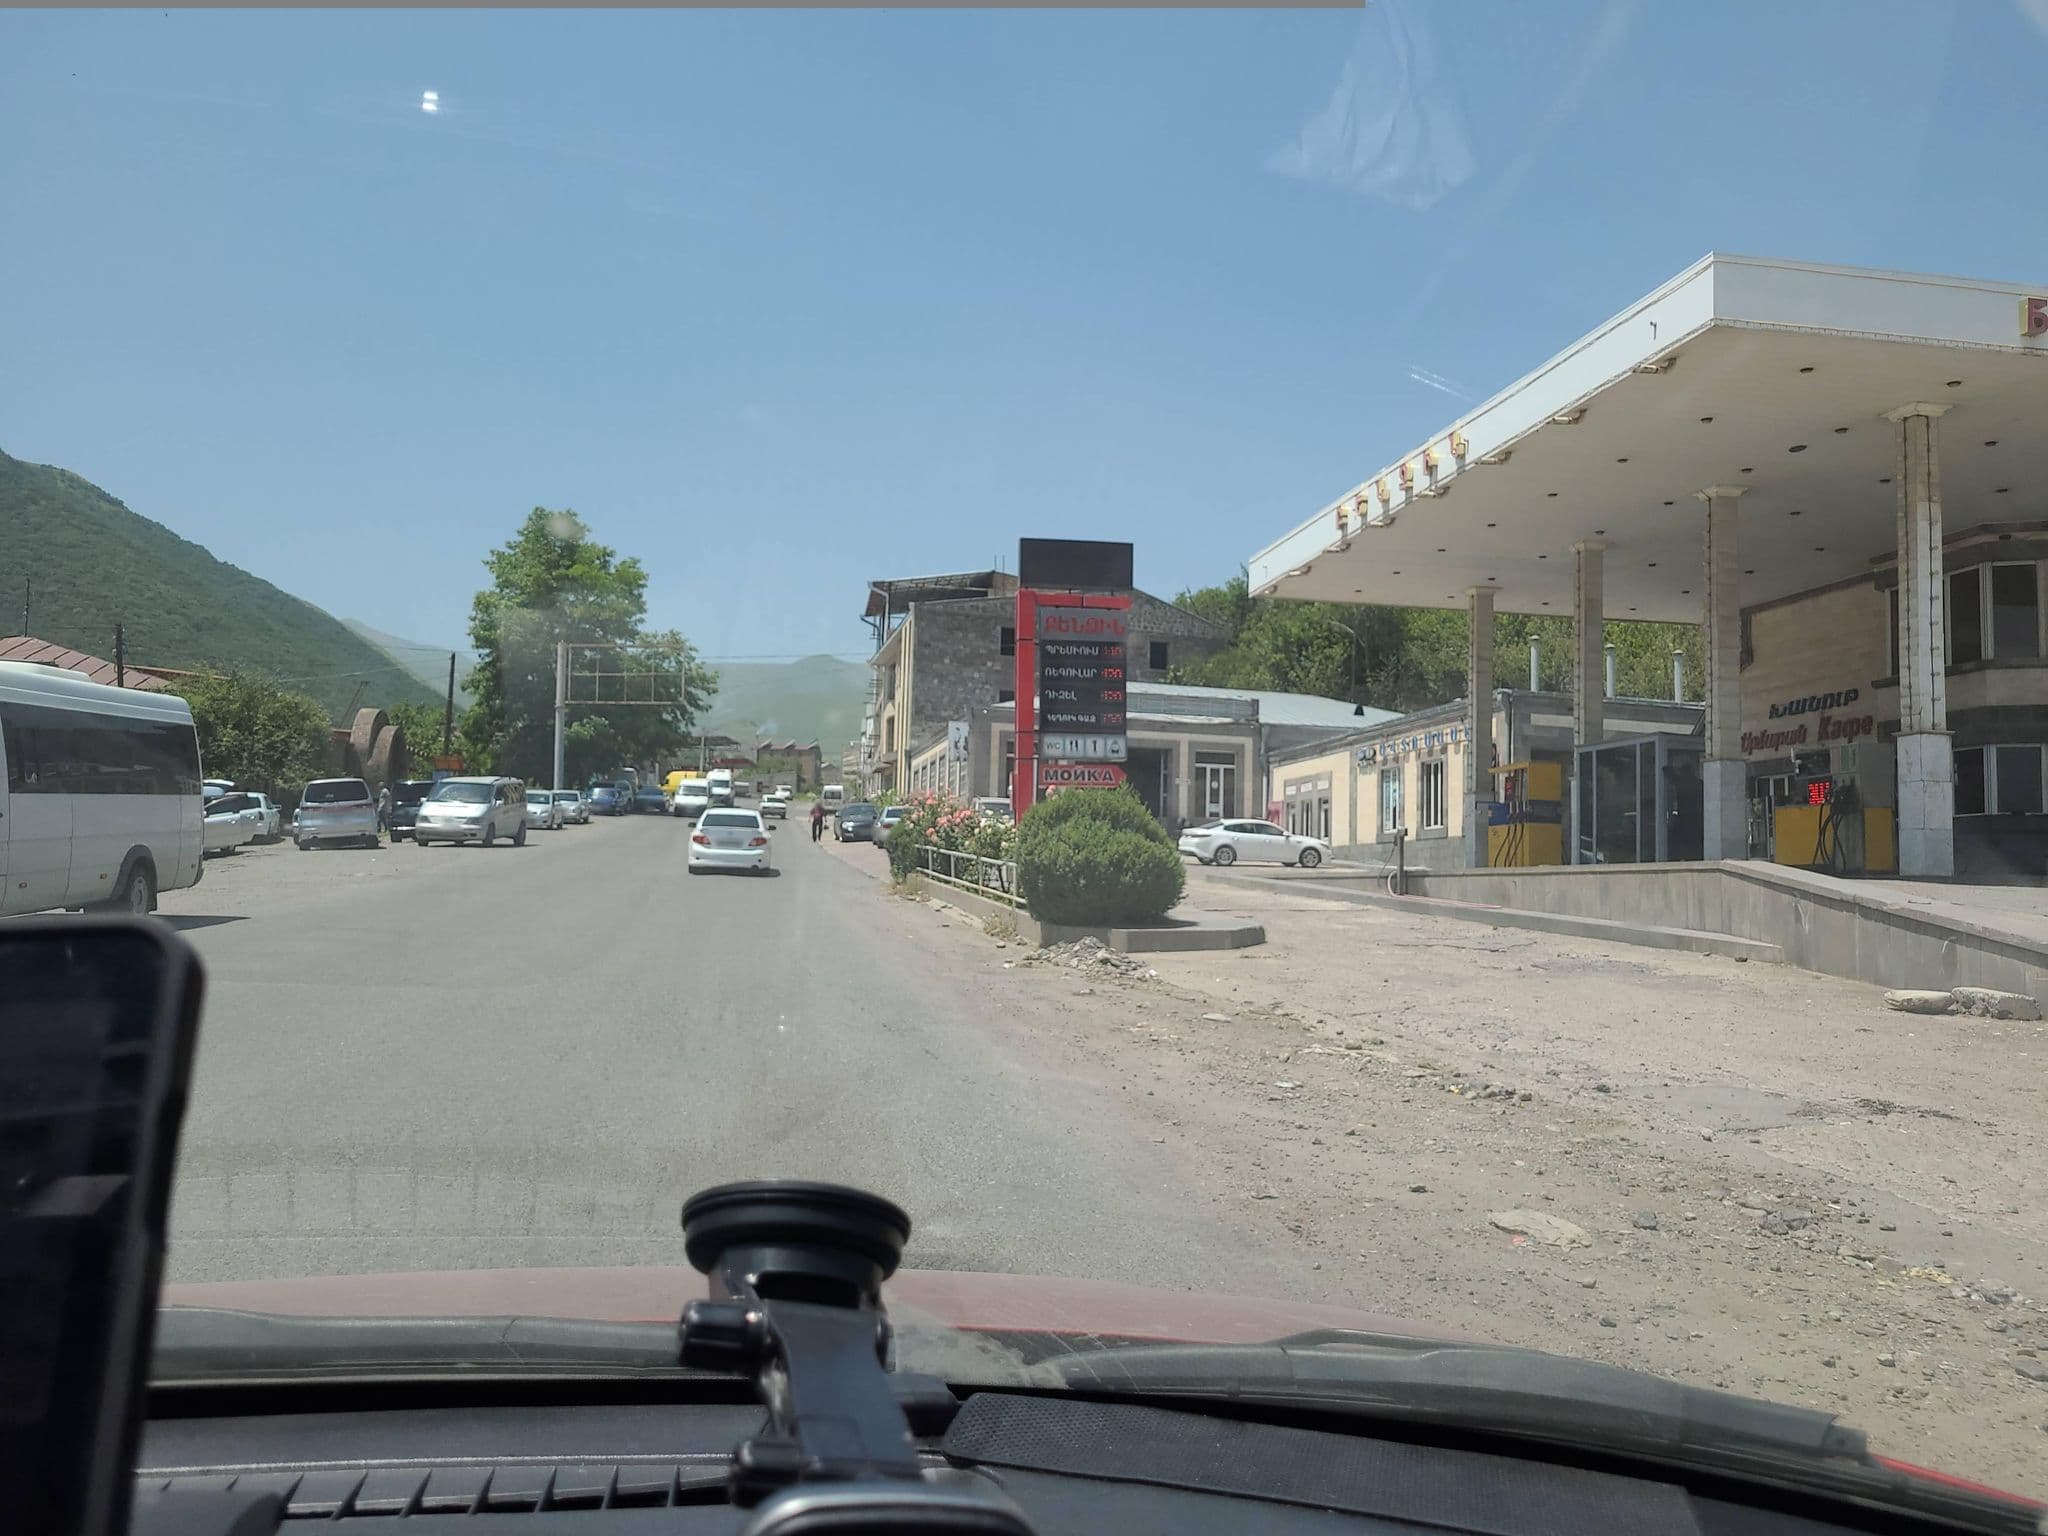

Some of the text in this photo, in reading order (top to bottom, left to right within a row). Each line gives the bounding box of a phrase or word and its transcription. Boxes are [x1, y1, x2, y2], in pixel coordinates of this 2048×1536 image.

[1045, 615, 1126, 637] ԲԵՆԶԻՆ
[1817, 715, 1873, 743] Кафе
[1044, 766, 1114, 781] МОЙКА
